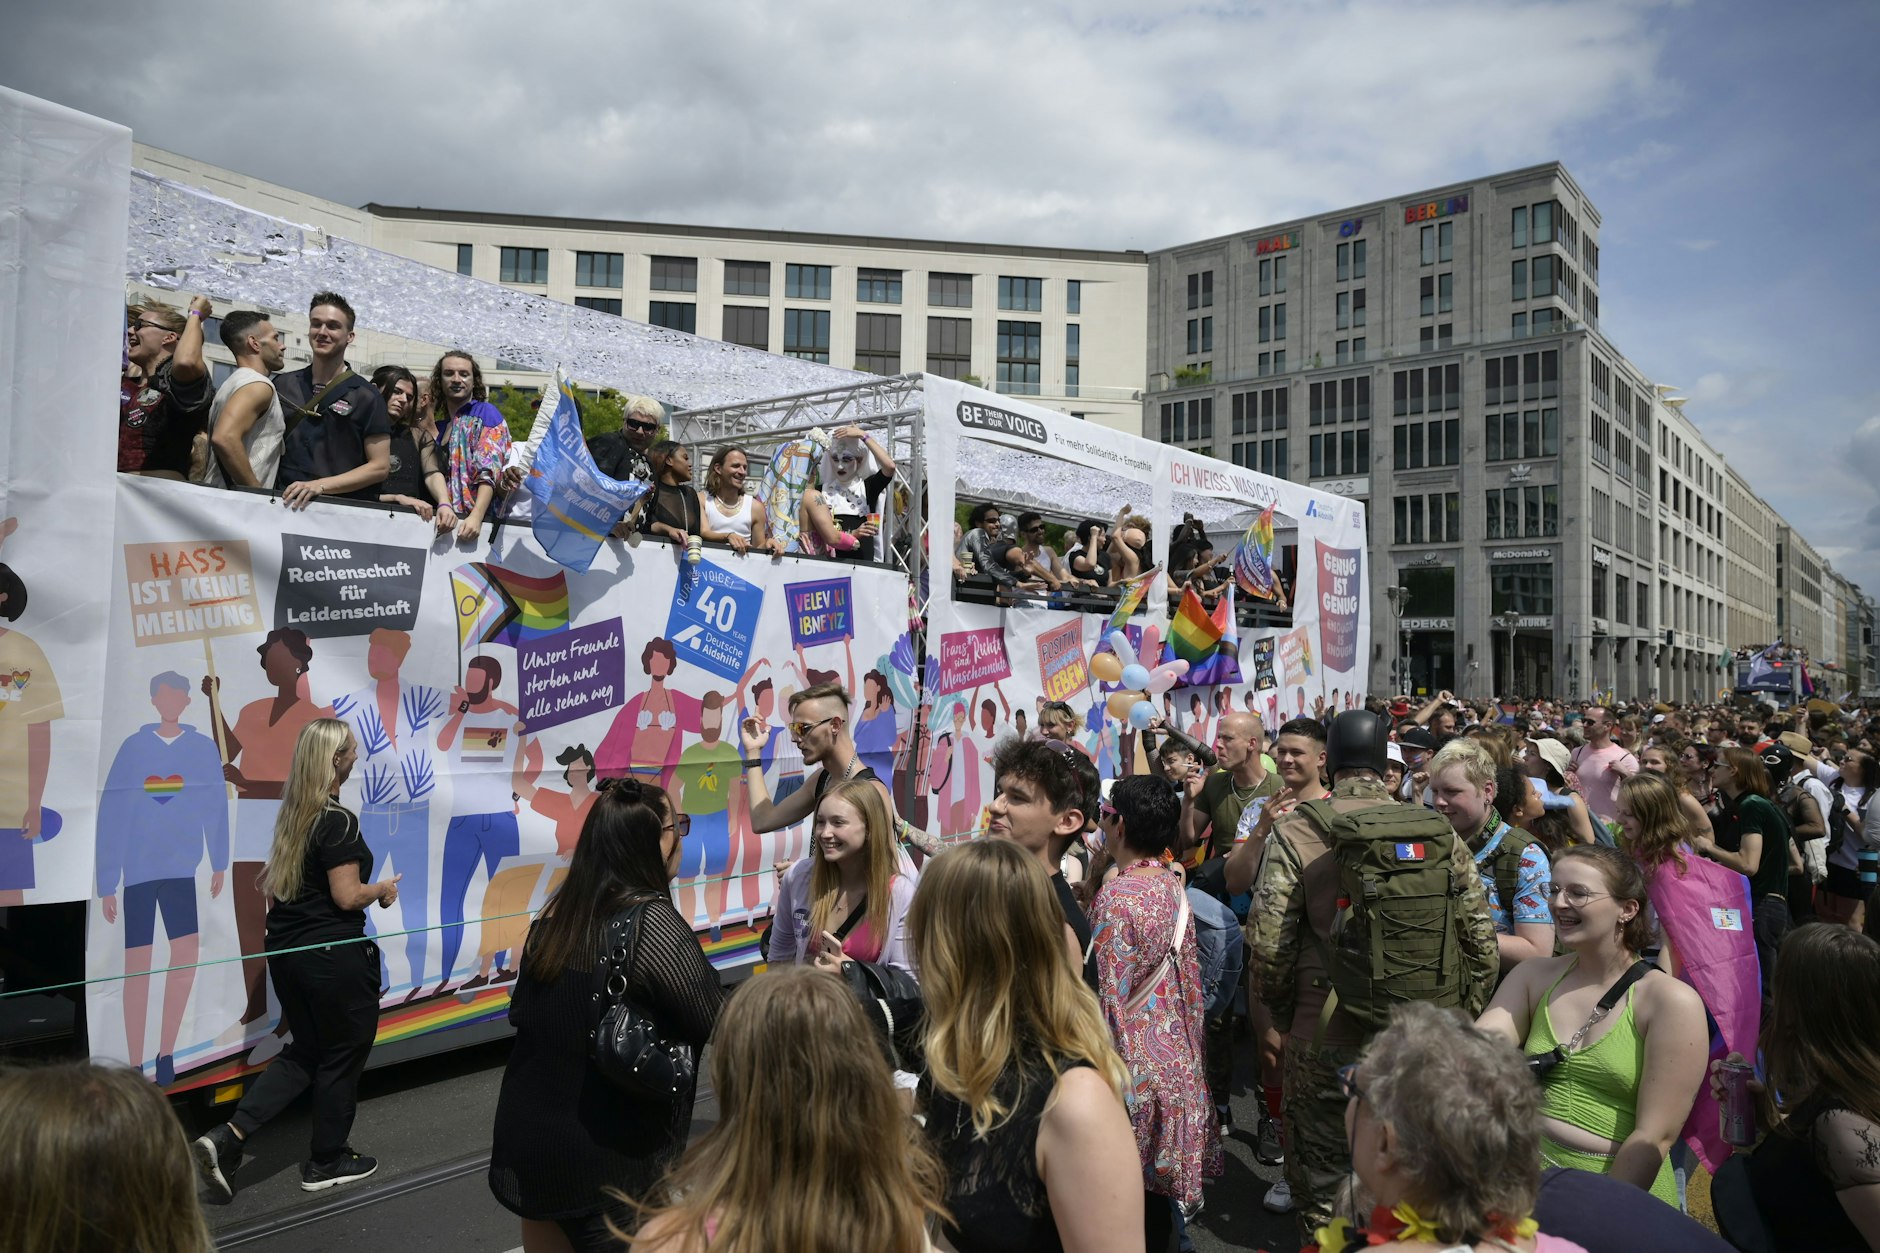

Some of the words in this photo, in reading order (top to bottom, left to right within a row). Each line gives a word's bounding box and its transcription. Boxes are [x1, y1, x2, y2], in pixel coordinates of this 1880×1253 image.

[1256, 232, 1299, 256] MALL
[1339, 218, 1363, 238] OF
[1405, 195, 1469, 225] BERLIN
[961, 404, 983, 424] BE
[984, 408, 1005, 420] THEIR
[1004, 413, 1044, 440] VOICE
[988, 418, 1003, 429] OUR
[1066, 439, 1085, 452] mehr
[1085, 443, 1119, 463] Solidarität
[1124, 456, 1152, 473] Empathie
[1170, 461, 1190, 486] ICH
[1192, 466, 1231, 492] WEISS
[1324, 481, 1355, 494] COS
[150, 546, 226, 578] HASS
[300, 545, 351, 562] Keine
[1323, 551, 1357, 576] GENUG
[1493, 549, 1550, 559] McDonald's
[288, 561, 411, 583] Rechenschaft
[131, 580, 171, 605] IST
[181, 573, 250, 601] KEINE
[339, 585, 367, 601] für
[676, 582, 693, 607] OUR
[702, 570, 735, 589] VOICE!
[1333, 576, 1348, 596] IST
[287, 600, 411, 624] Leidenschaft
[696, 585, 737, 633] 40
[794, 590, 830, 613] VELEV
[1323, 591, 1357, 615] GENUG
[136, 603, 254, 637] MEINUNG
[1327, 618, 1353, 634] ENOUGH
[1401, 619, 1449, 629] EDEKA
[1516, 616, 1547, 627] ATURN
[523, 649, 567, 671] Unsere
[570, 632, 619, 658] Freunde
[705, 632, 743, 658] Deutsche
[1042, 628, 1077, 662] POSITIV
[1327, 642, 1353, 658] ENOUGH
[1338, 635, 1344, 646] IS
[702, 644, 740, 669] Aidshilfe
[954, 653, 971, 669] sind
[525, 668, 571, 696] sterben
[573, 659, 599, 681] und
[1046, 661, 1086, 702] LEBEN
[526, 697, 551, 719] alle
[554, 690, 589, 712] sehen
[591, 684, 613, 706] weg
